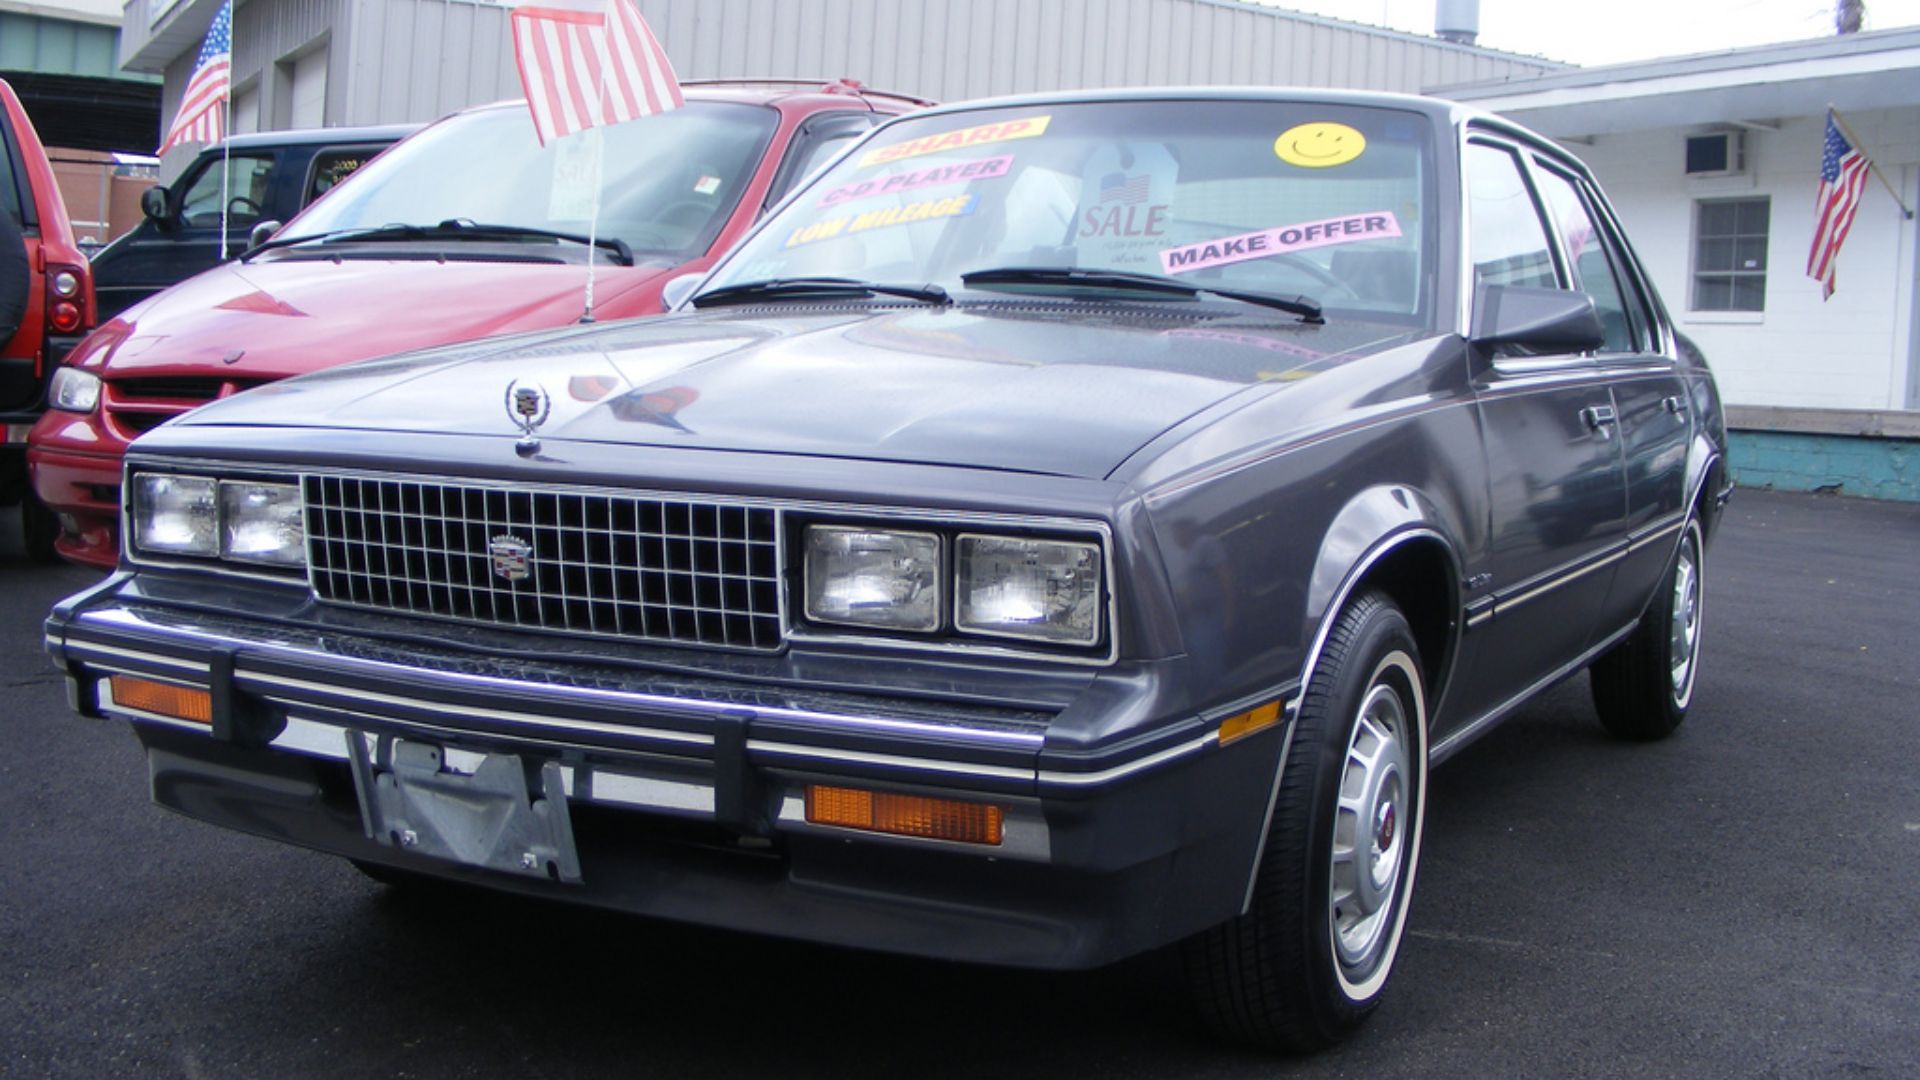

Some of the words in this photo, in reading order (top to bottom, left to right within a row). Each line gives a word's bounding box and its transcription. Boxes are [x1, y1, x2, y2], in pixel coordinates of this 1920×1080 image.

[874, 121, 1032, 162] SHARP
[882, 158, 1006, 190] PLAYER
[785, 216, 849, 248] LOW
[848, 194, 972, 233] MILEAGE
[1080, 204, 1169, 238] SALE
[1168, 234, 1267, 268] MAKE
[1279, 215, 1388, 245] OFFER
